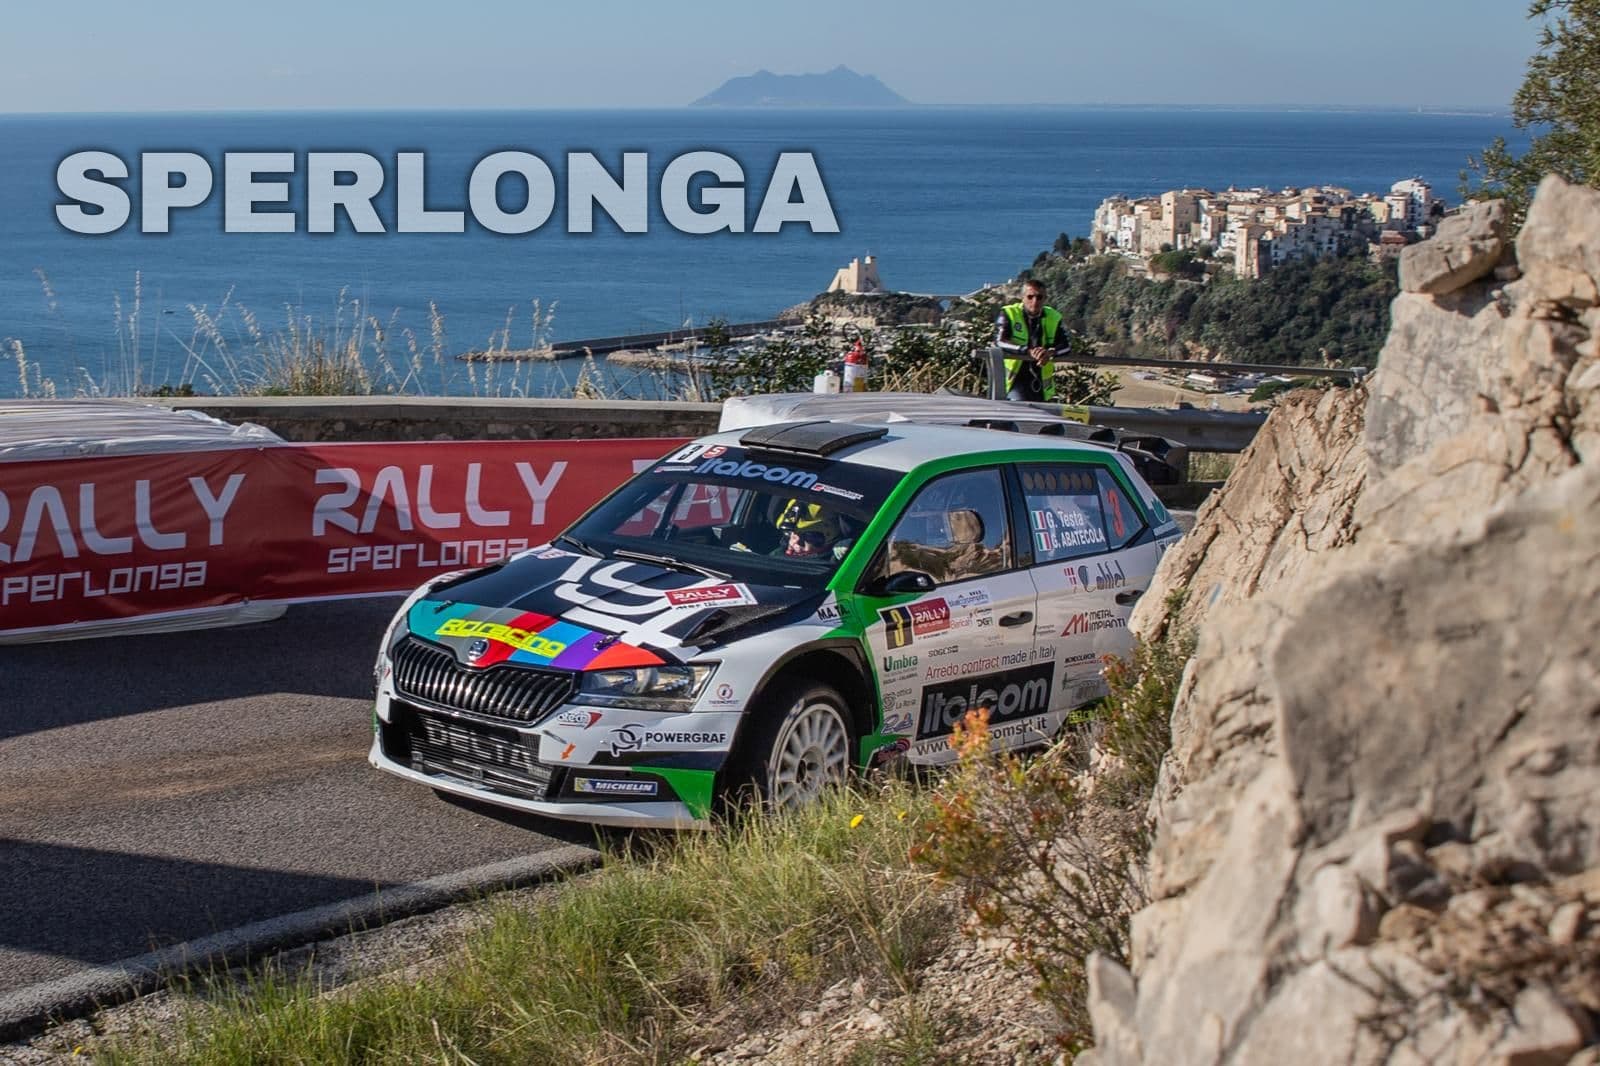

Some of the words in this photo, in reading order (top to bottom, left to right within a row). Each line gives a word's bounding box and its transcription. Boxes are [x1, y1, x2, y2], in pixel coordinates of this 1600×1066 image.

[694, 458, 818, 489] Italcom
[312, 461, 568, 537] RALLY
[1046, 513, 1057, 529] G.
[1059, 511, 1085, 527] Testa
[1107, 490, 1125, 537] 3
[1061, 528, 1106, 548] ABATECOLA
[914, 607, 947, 624] RALLY
[1089, 609, 1114, 620] METAL
[889, 608, 905, 647] 3
[1089, 618, 1126, 632] IMPIANTI
[883, 654, 919, 673] Umbra
[925, 662, 959, 680] Arredo
[961, 655, 1000, 675] contract
[1001, 651, 1026, 666] made
[1029, 649, 1038, 661] in
[1039, 646, 1056, 660] Italy
[922, 678, 1048, 734] Italcom
[645, 732, 727, 744] POWERGRAF
[595, 782, 653, 792] MICHELIN
